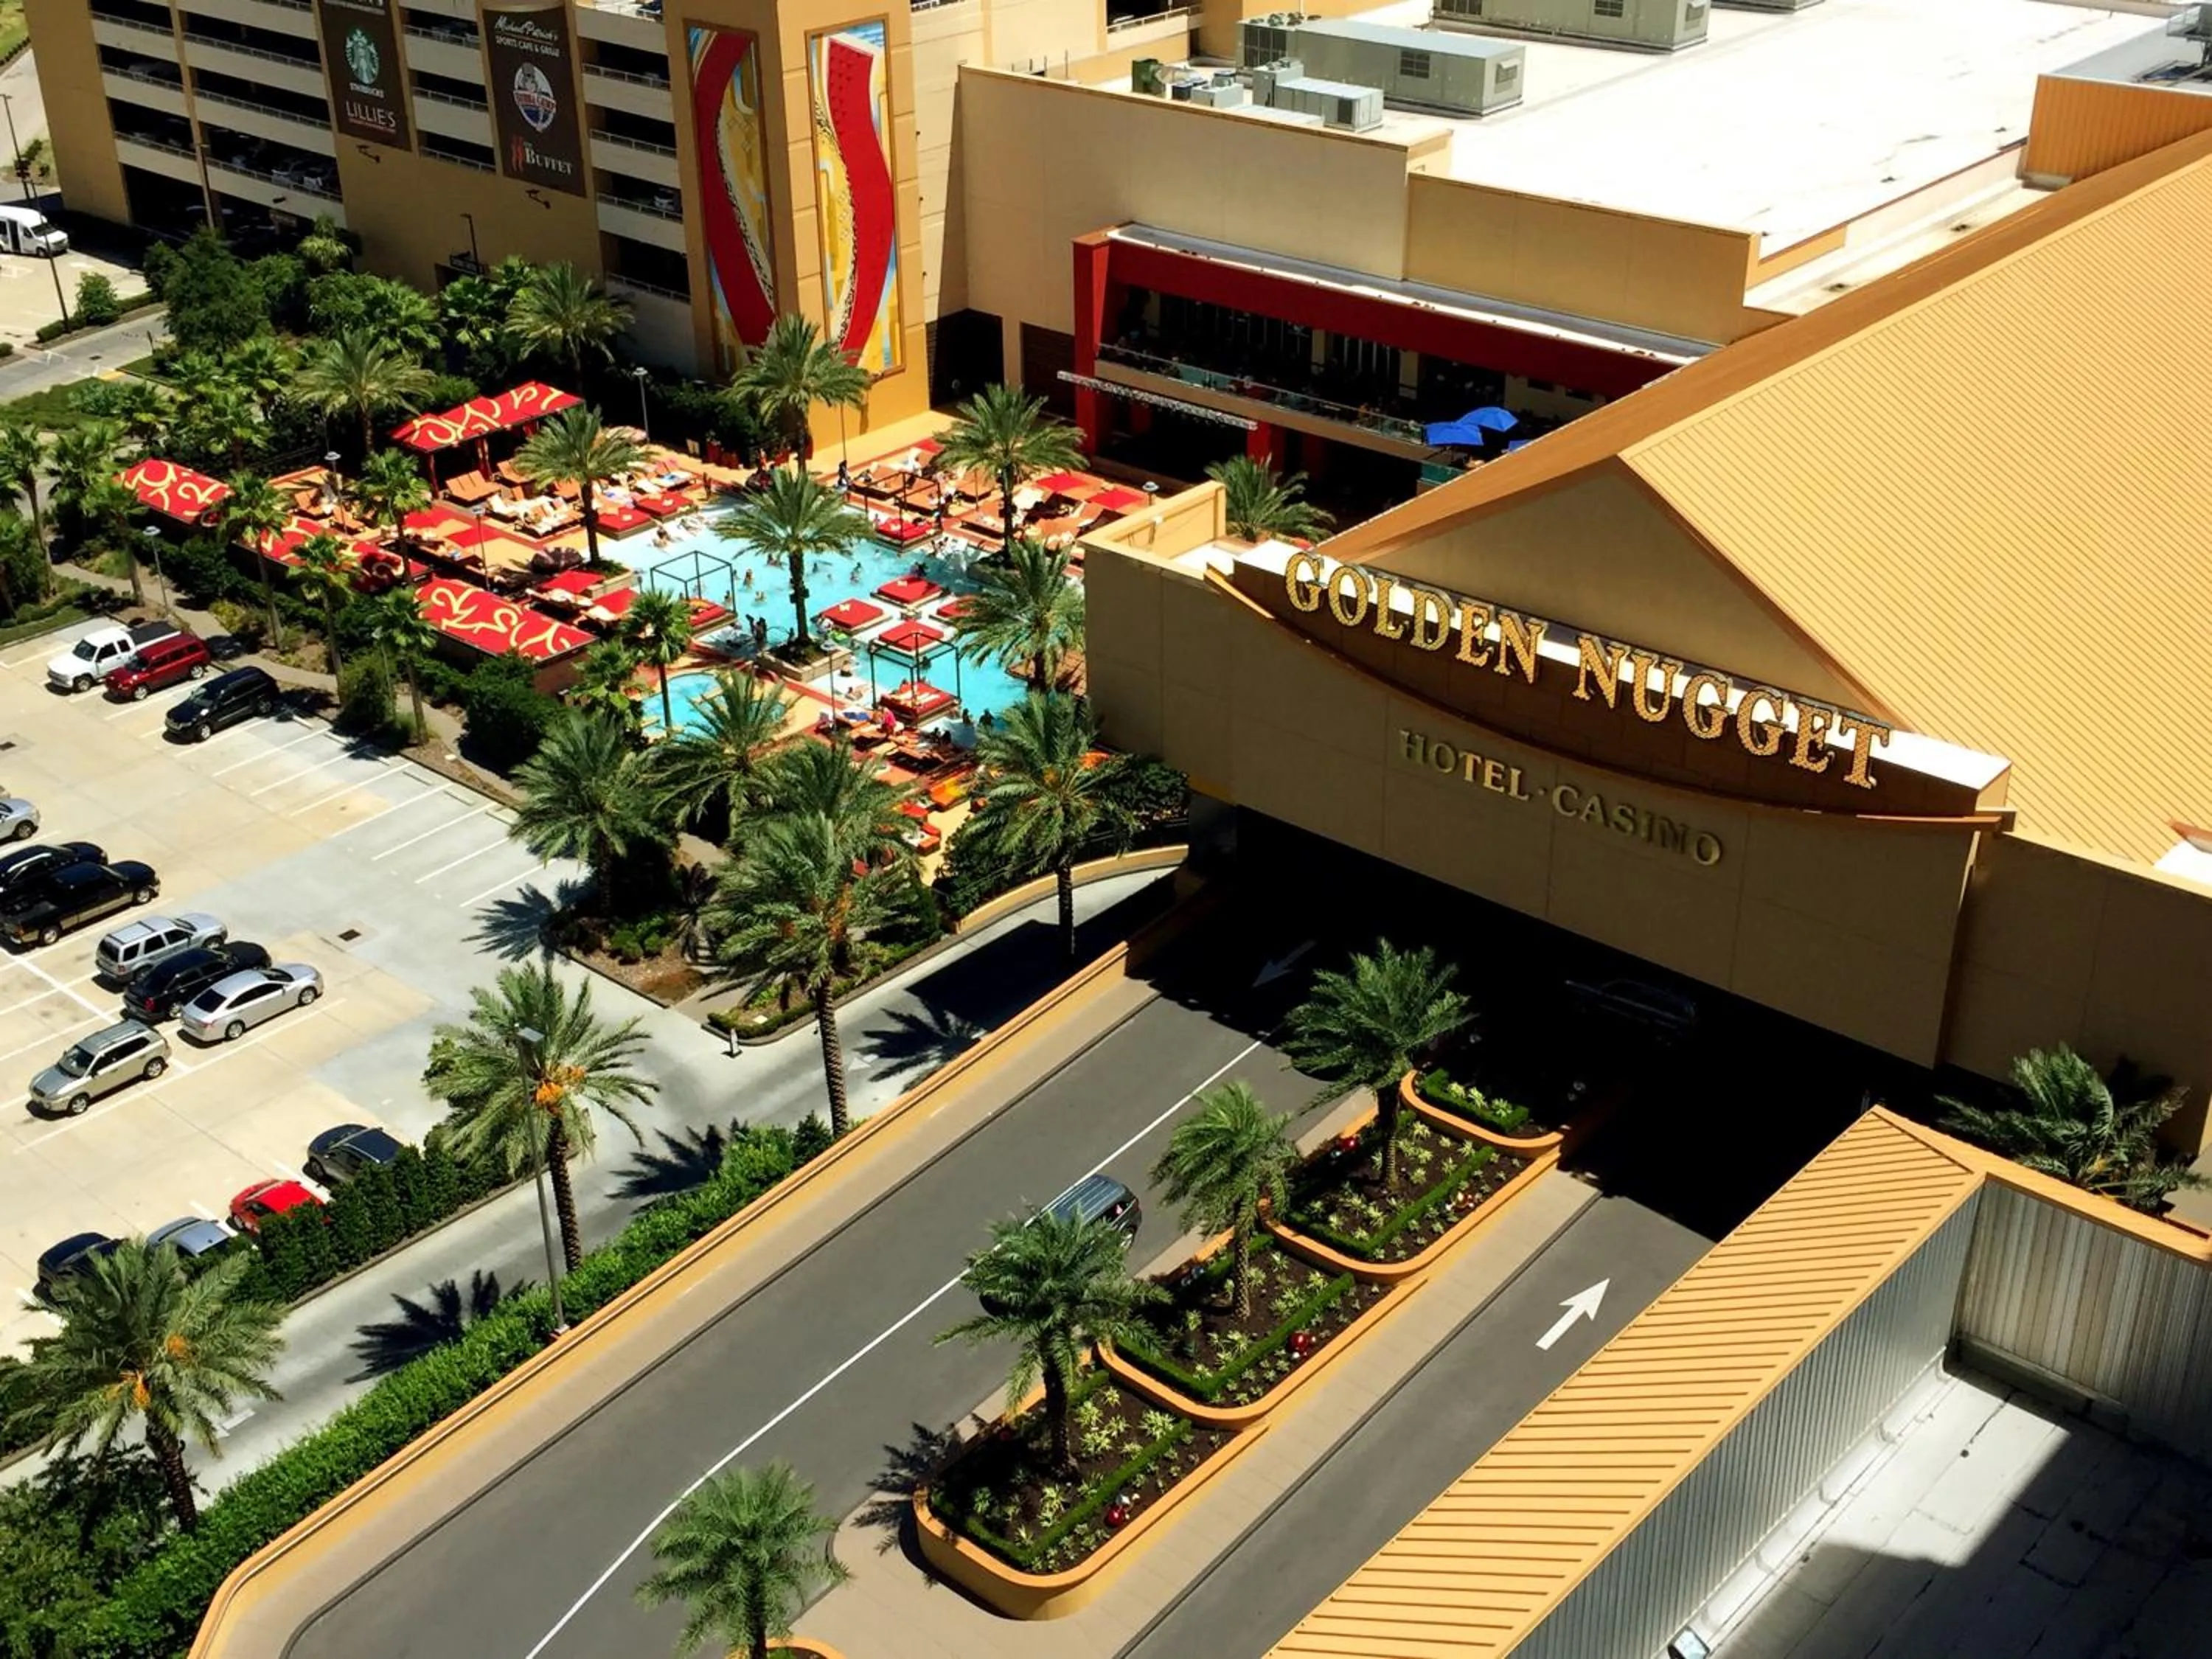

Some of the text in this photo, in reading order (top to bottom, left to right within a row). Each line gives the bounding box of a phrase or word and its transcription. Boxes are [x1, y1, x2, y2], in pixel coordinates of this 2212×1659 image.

[1285, 552, 1890, 789] GOLDEN NUGGET
[1399, 728, 1722, 866] HOTEL CASINO
